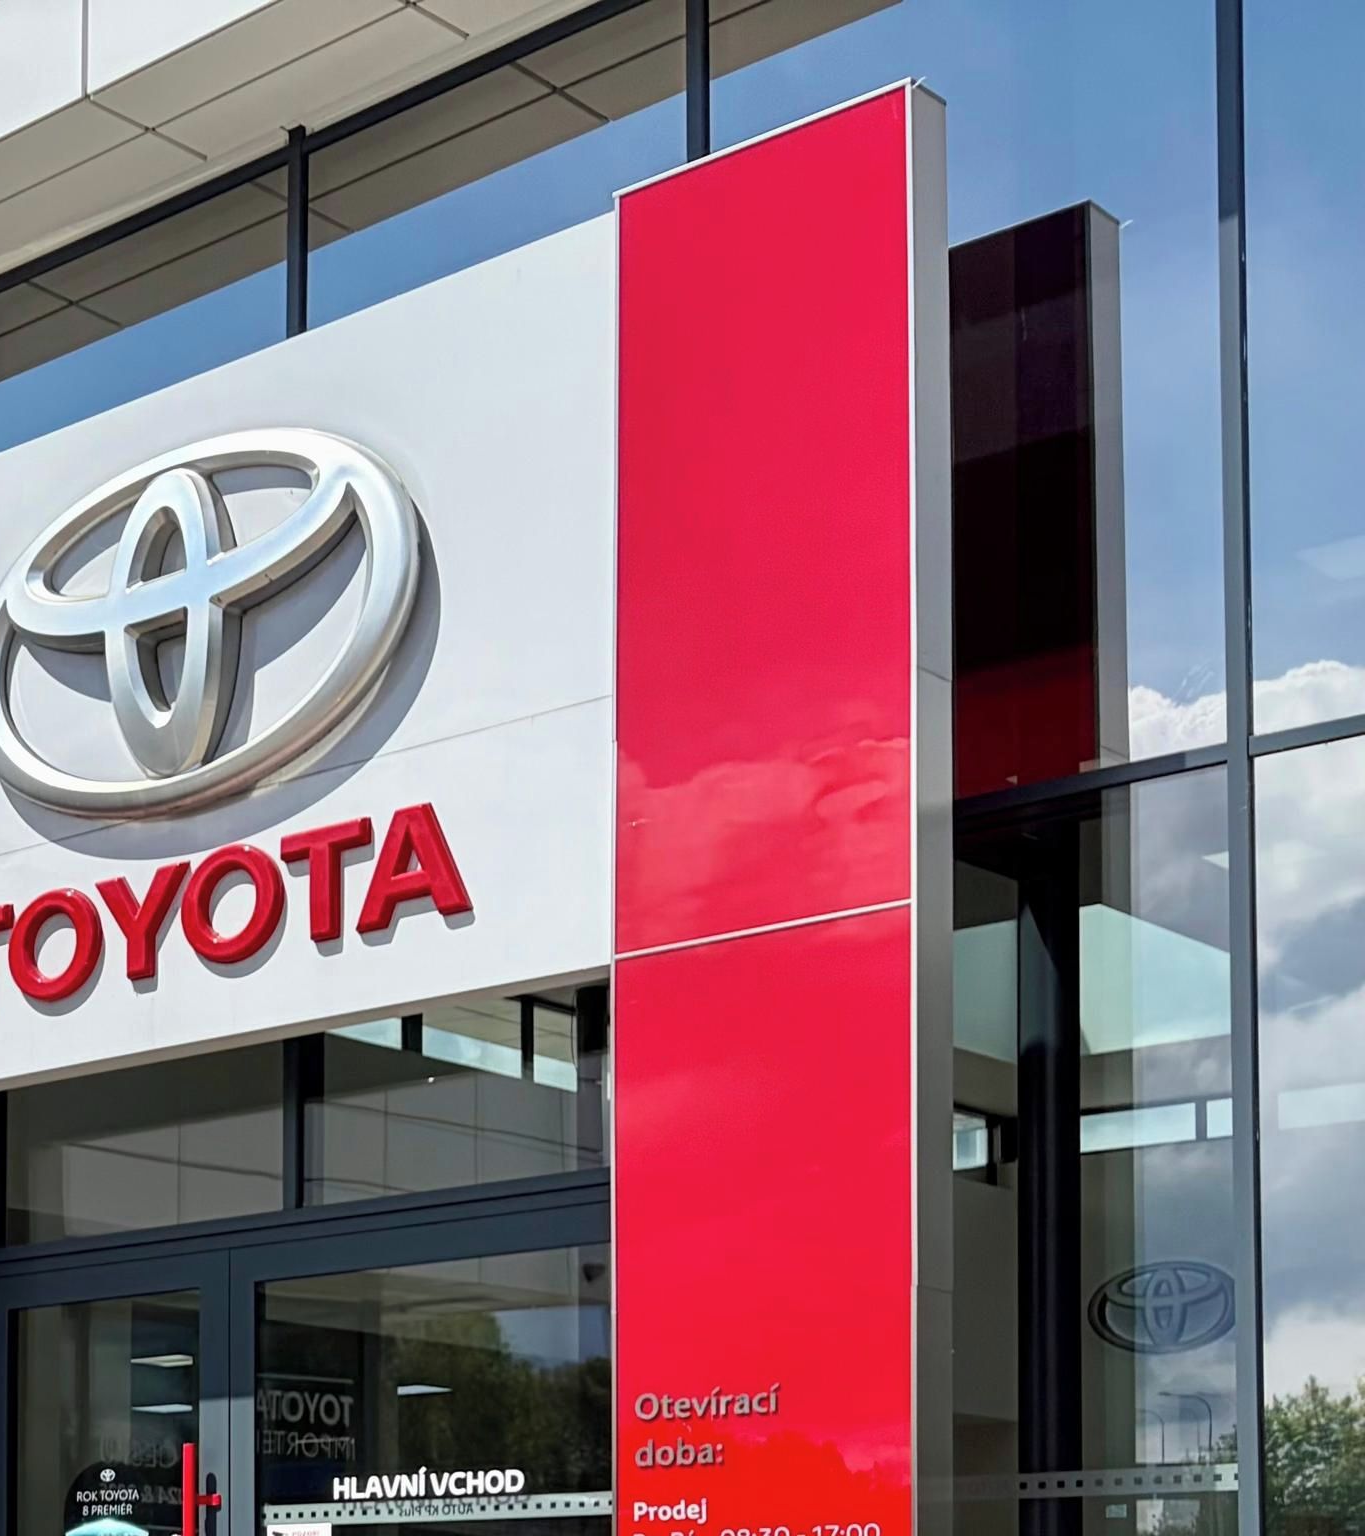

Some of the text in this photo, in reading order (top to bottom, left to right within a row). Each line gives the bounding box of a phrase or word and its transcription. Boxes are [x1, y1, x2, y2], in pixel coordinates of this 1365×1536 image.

[634, 1382, 780, 1420] Otevírací
[634, 1437, 724, 1468] doba:
[76, 1491, 99, 1503] ROK
[99, 1488, 140, 1502] TOYOTA
[333, 1466, 525, 1500] HLAVNÍ VCHOD
[91, 1502, 133, 1516] PREMIÉR
[633, 1498, 708, 1525] Prodej
